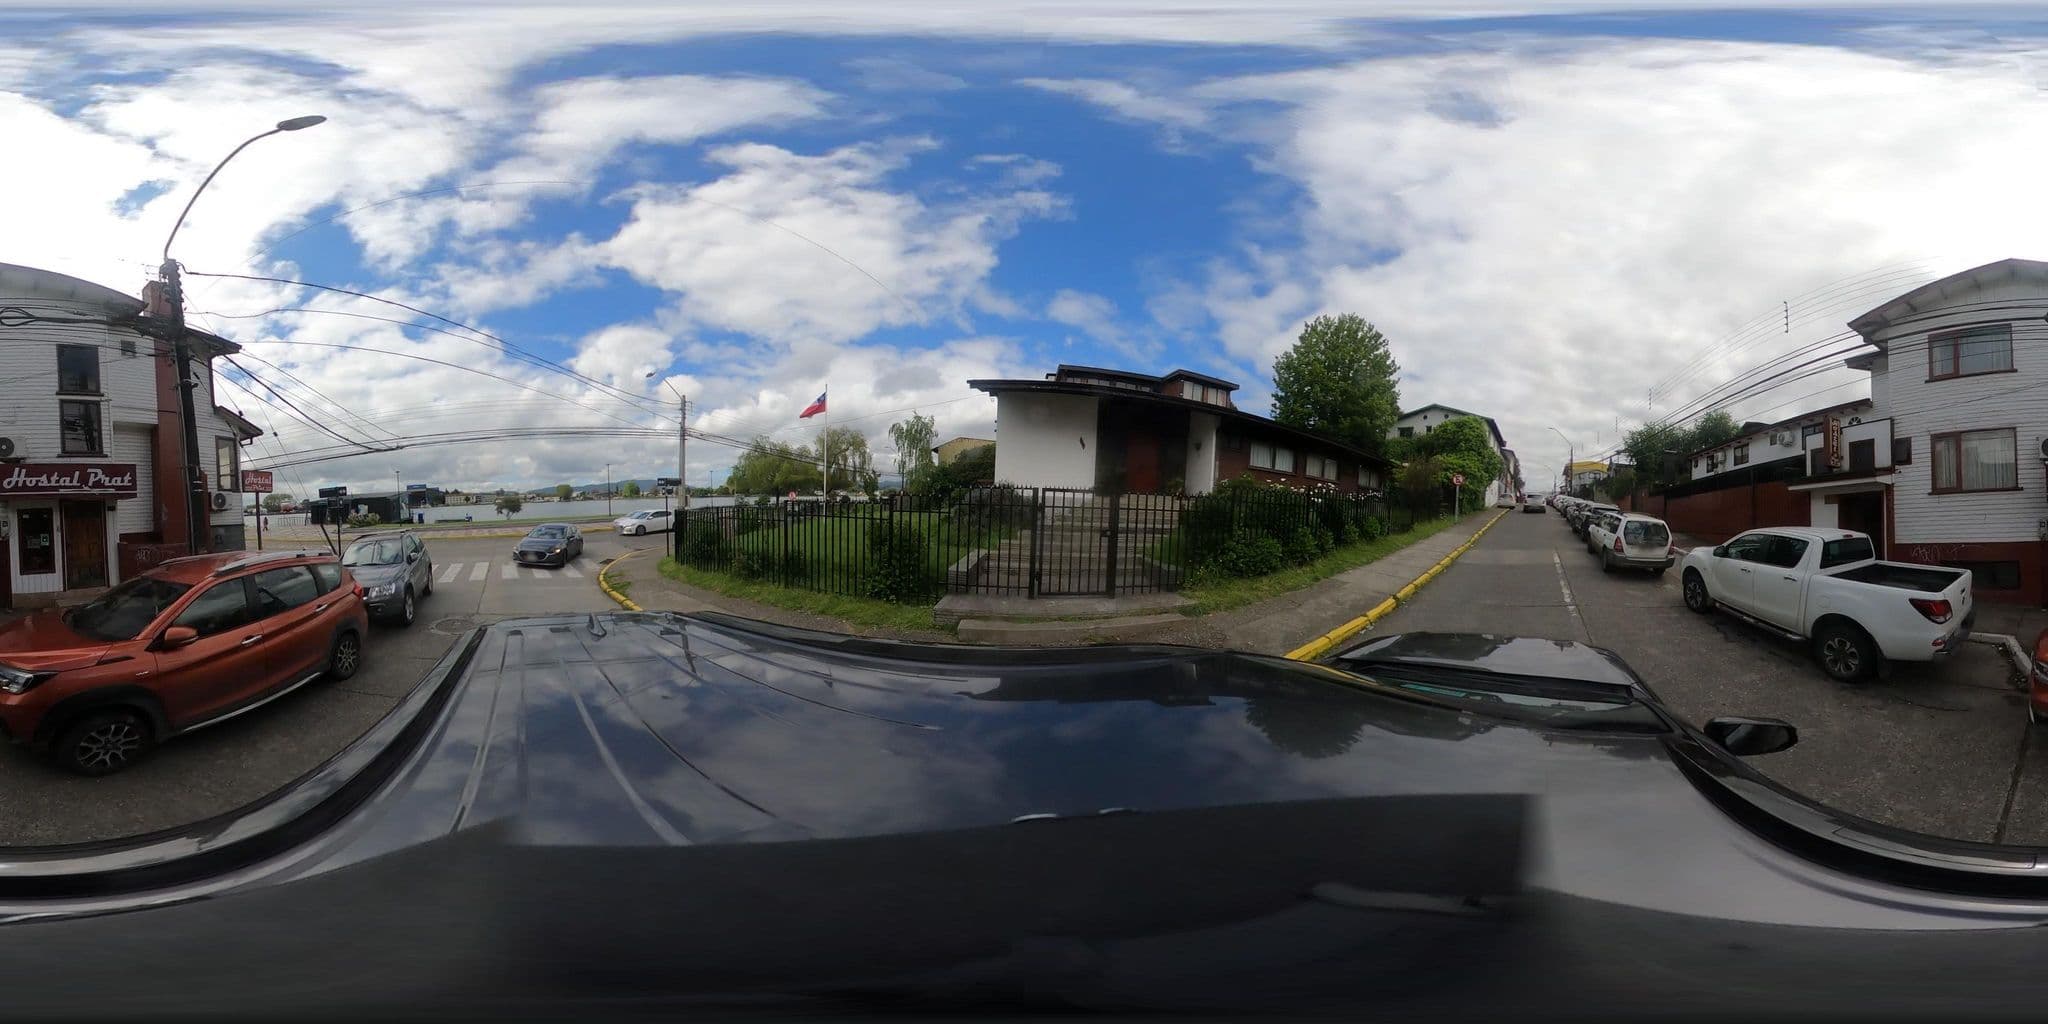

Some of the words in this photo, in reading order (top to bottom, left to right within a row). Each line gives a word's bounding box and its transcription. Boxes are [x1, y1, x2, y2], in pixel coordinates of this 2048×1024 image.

[2, 467, 80, 489] Hostal
[87, 468, 132, 487] Prat
[245, 472, 271, 485] Hostal
